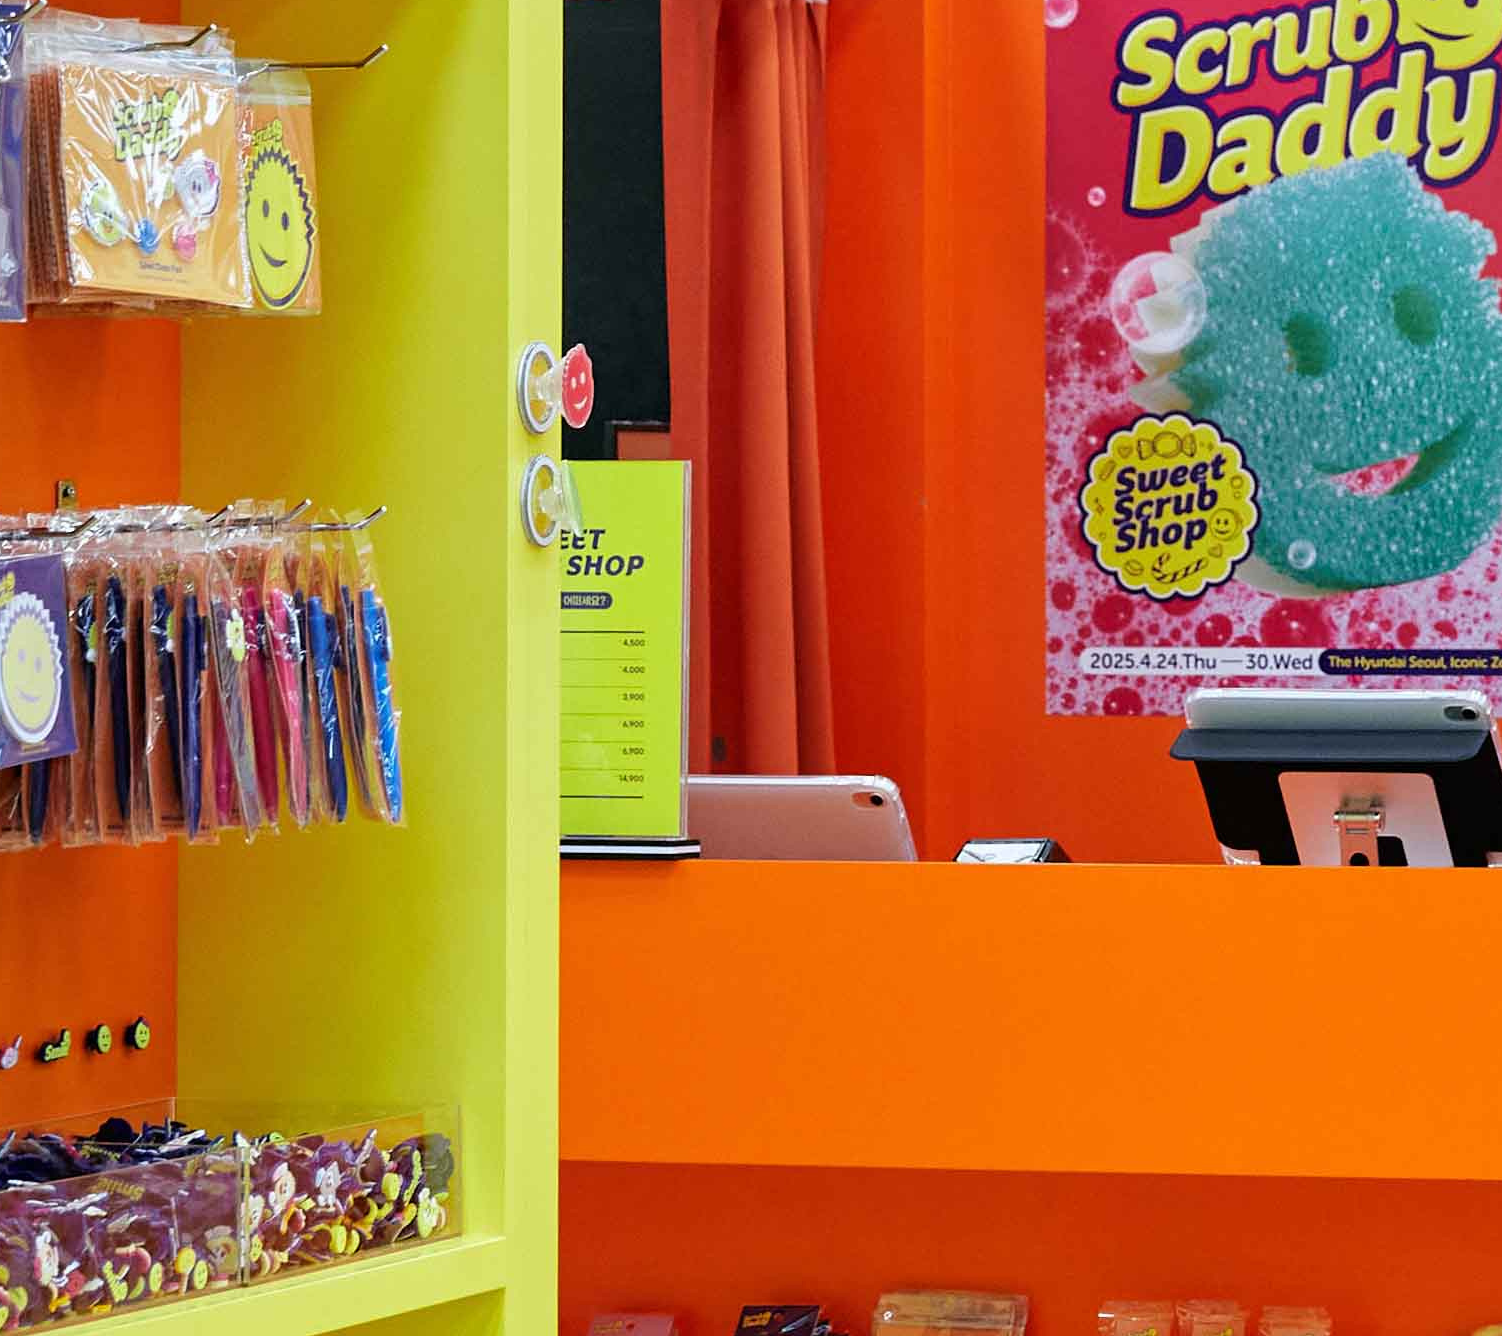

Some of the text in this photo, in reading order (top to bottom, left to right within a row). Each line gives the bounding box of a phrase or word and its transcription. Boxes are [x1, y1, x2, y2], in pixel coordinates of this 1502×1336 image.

[1127, 47, 1499, 212] Daddy
[1114, 452, 1228, 499] Sweet
[1113, 482, 1219, 528] Scrub
[1115, 514, 1208, 554] Shop
[566, 554, 645, 576] SHOP
[1089, 652, 1218, 671] 2025.4.24.Thu
[1245, 652, 1314, 671] 30.Wed
[1328, 655, 1352, 669] The
[1354, 655, 1406, 671] Hyundai
[1408, 655, 1448, 670] Seoul,
[1450, 655, 1488, 669] Iconic
